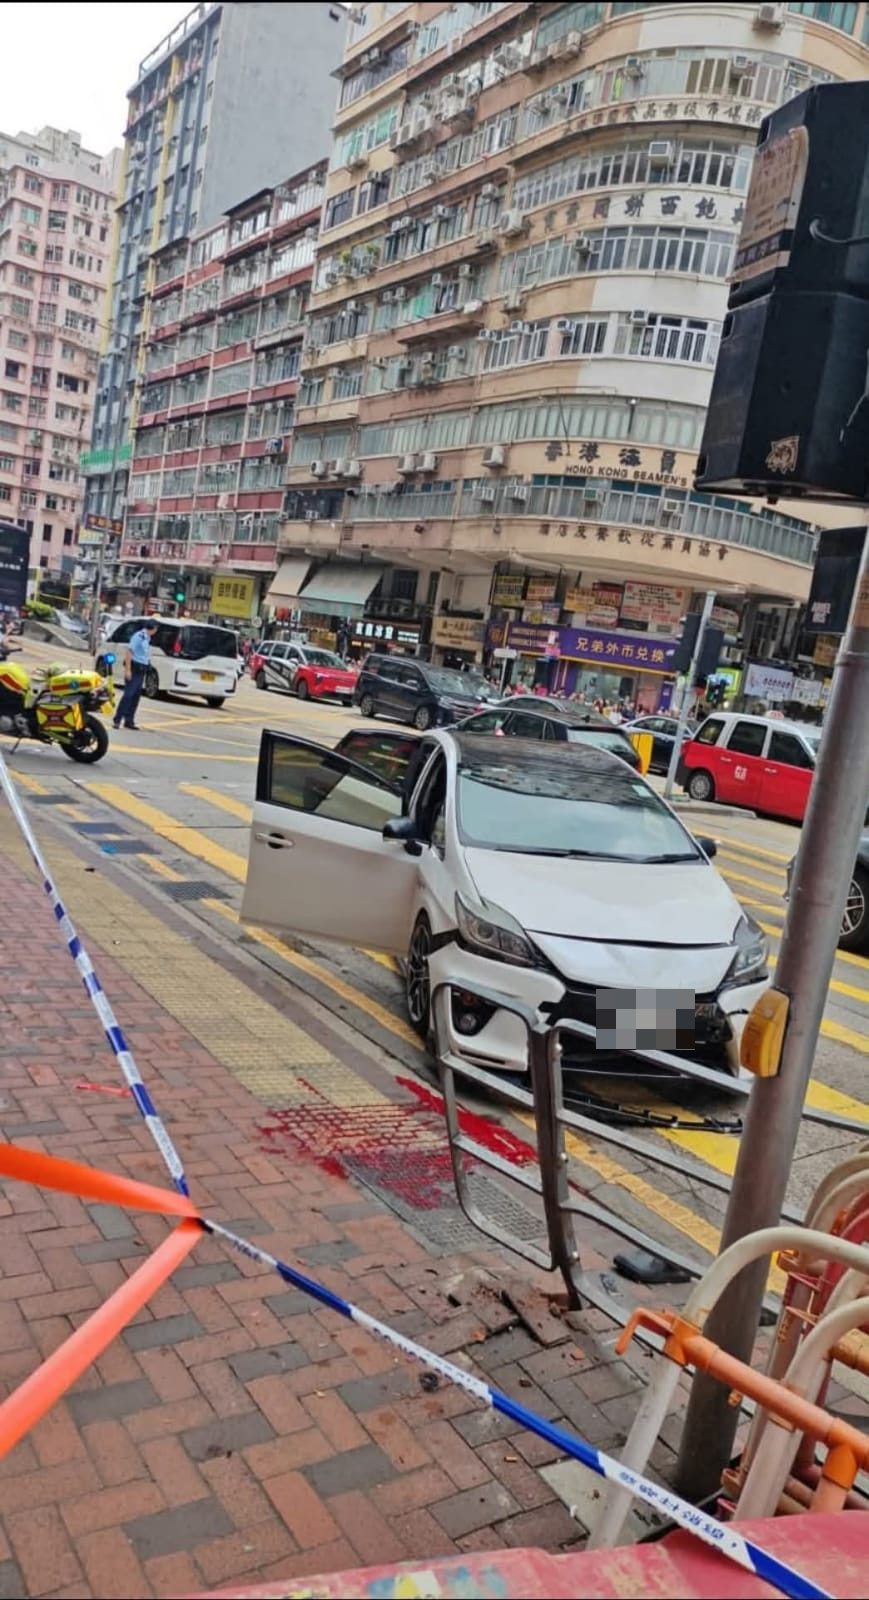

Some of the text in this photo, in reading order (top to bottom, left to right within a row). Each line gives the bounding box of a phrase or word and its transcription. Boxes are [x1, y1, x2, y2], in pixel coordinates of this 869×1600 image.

[545, 441, 697, 474] 香港海員
[566, 465, 688, 486] HONG KONG SEAMEN'S
